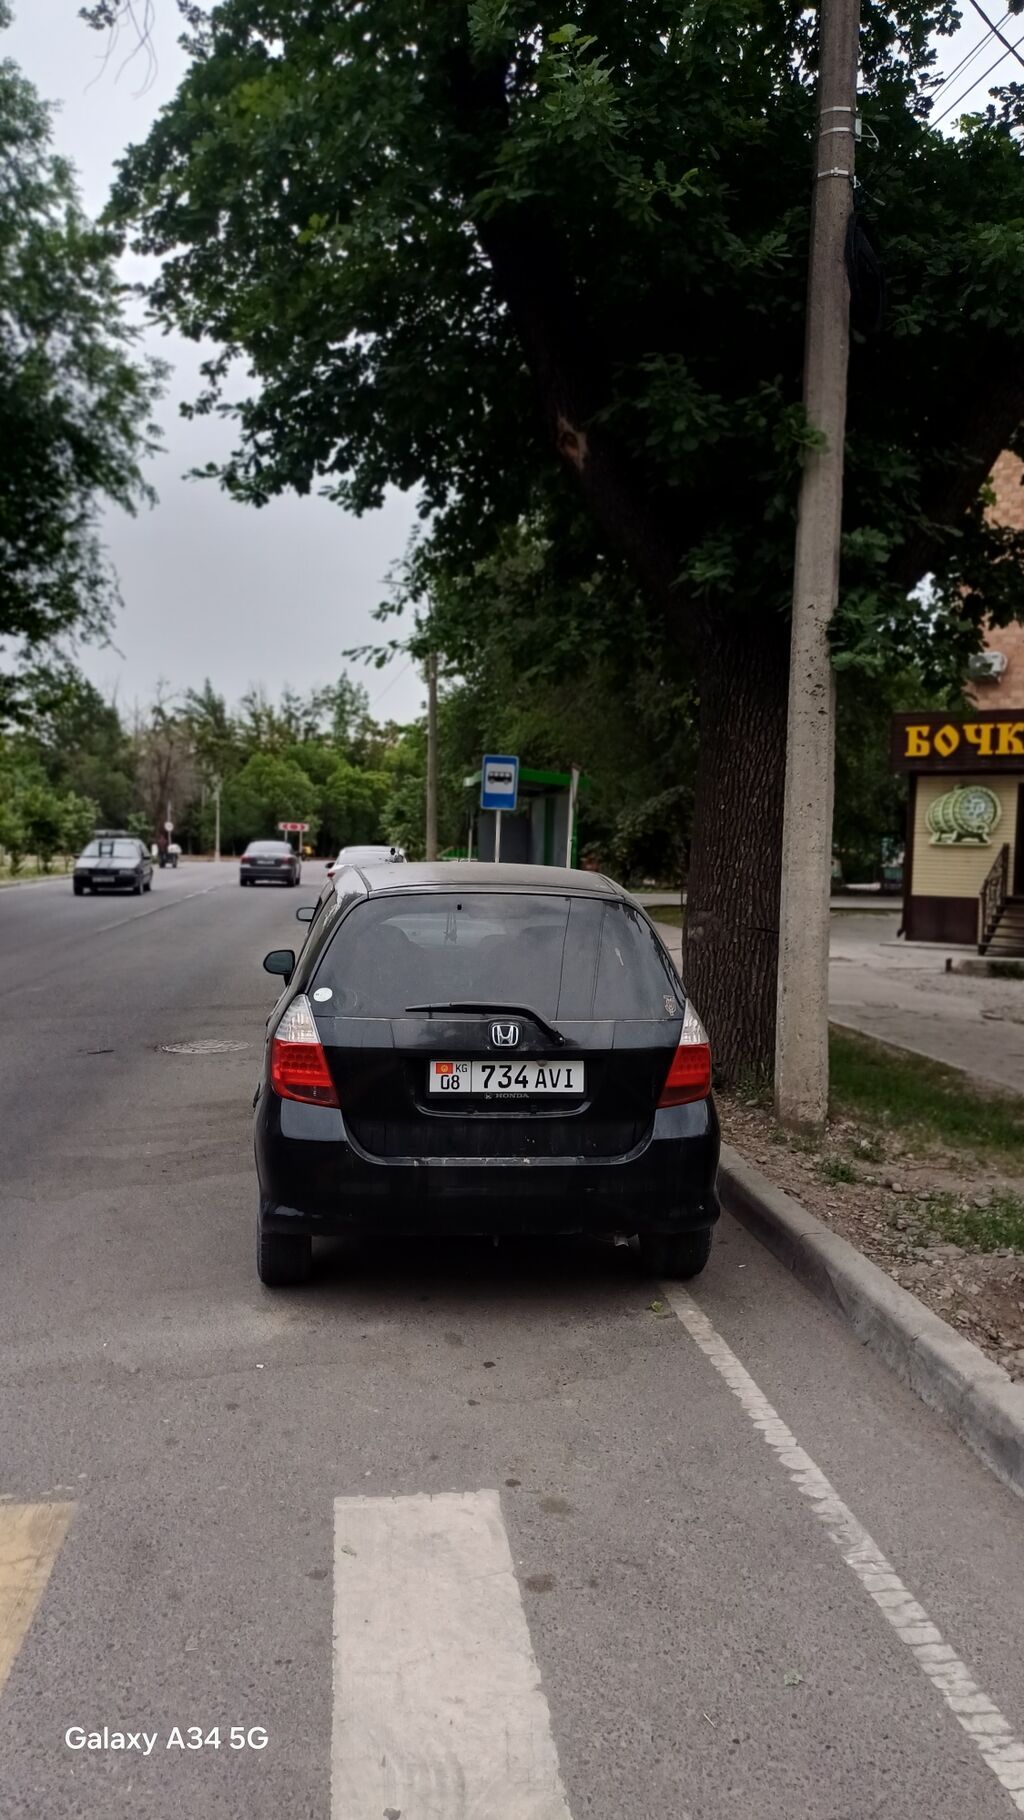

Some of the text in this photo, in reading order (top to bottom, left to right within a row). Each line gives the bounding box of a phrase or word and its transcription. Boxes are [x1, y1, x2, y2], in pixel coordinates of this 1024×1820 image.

[904, 722, 1024, 758] БОЧК
[455, 1064, 468, 1073] KG
[481, 1064, 573, 1089] 734 AVI
[440, 1074, 460, 1090] 08
